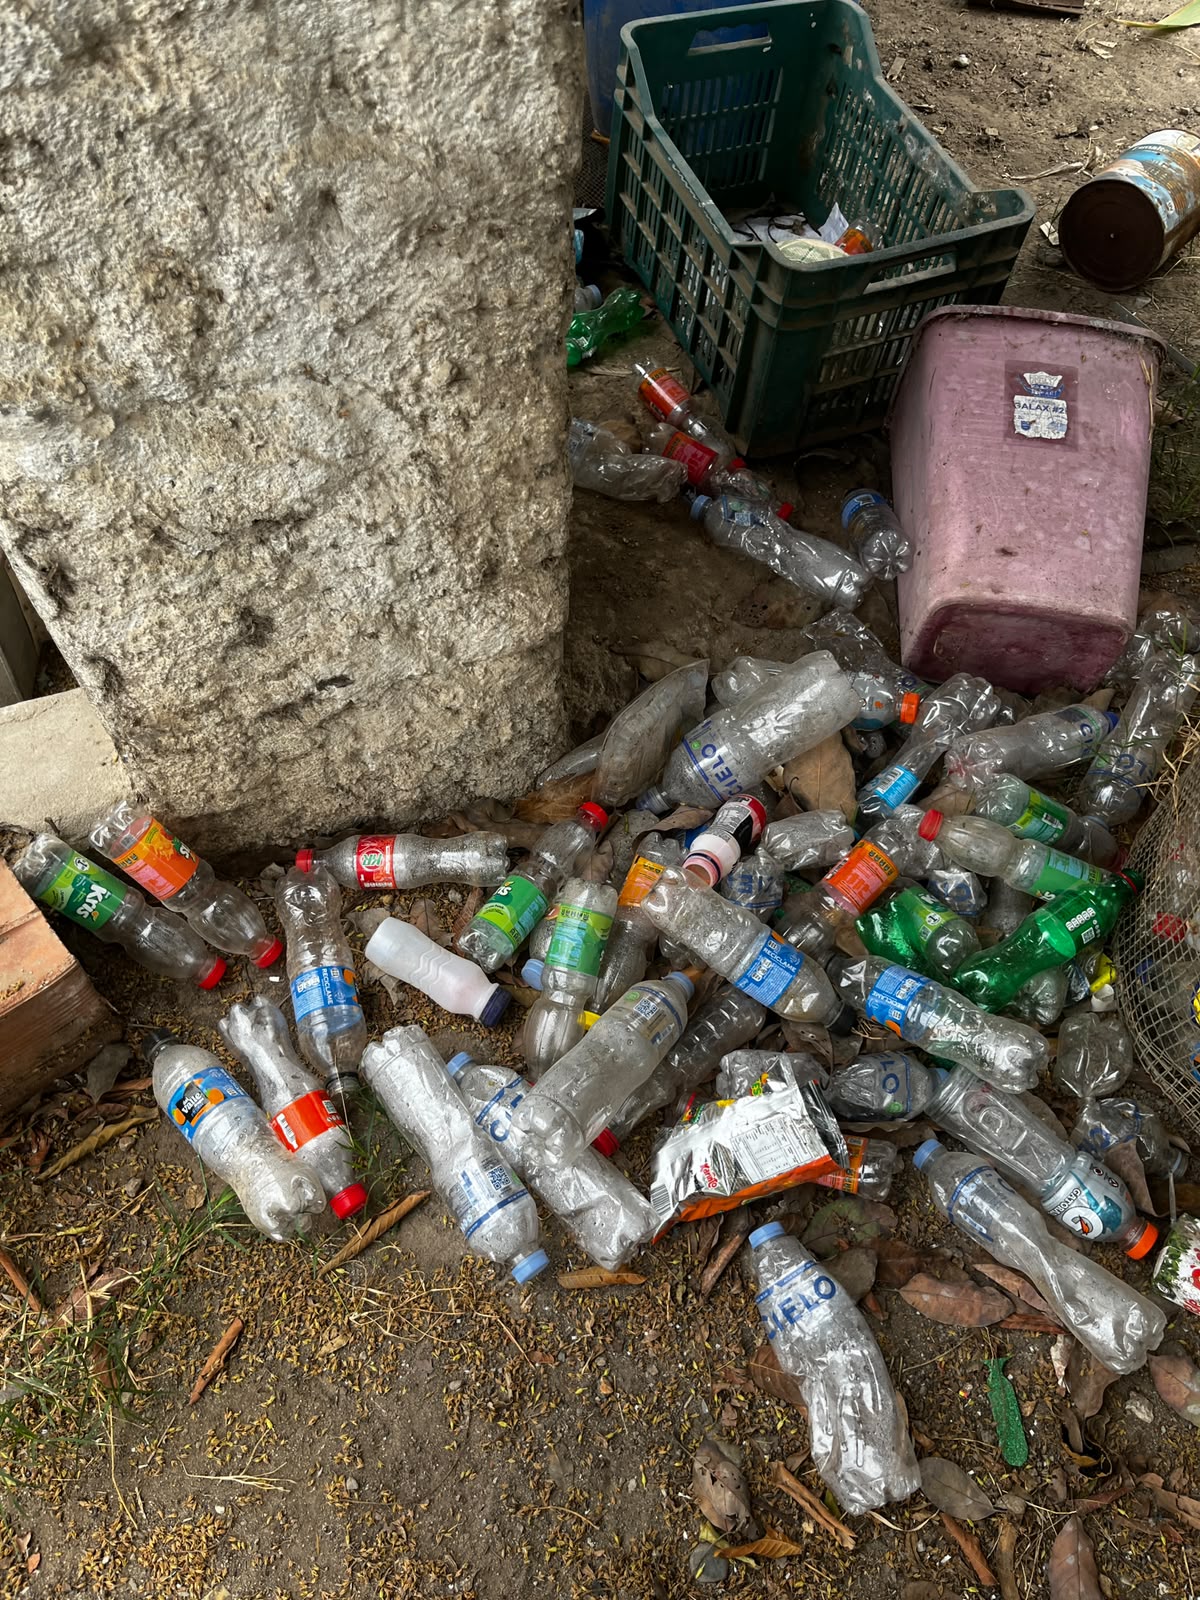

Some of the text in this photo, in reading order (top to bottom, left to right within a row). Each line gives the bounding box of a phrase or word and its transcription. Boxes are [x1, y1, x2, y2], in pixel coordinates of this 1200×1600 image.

[75, 883, 107, 919] Kris
[762, 947, 797, 973] RECICLAME
[321, 968, 334, 1005] RECICLAME
[871, 991, 906, 1011] RECICLAME
[1048, 1187, 1082, 1216] GATORA
